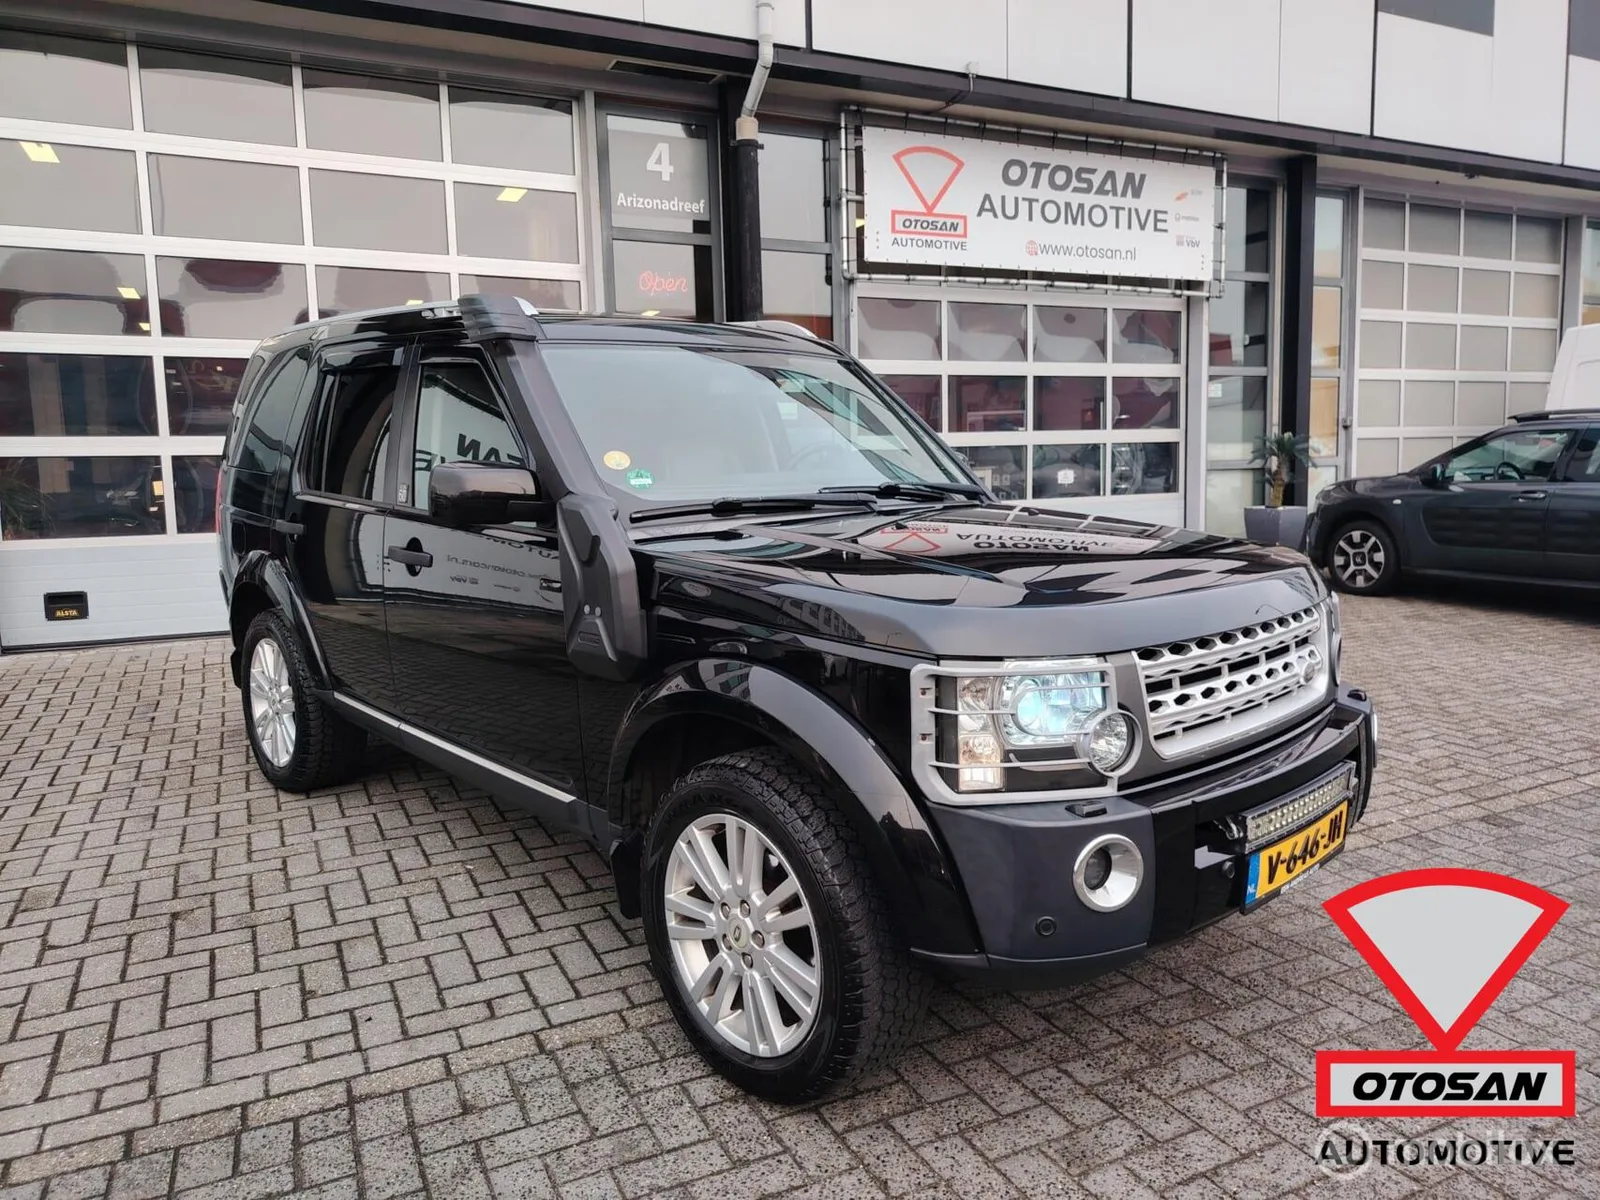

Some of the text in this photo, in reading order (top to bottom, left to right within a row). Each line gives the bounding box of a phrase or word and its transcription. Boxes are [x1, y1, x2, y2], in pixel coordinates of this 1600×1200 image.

[646, 142, 674, 181] 4
[1001, 158, 1146, 200] OTOSAN
[617, 192, 705, 214] Arizonadreef
[976, 193, 1169, 233] AUTOMOTIVE
[902, 218, 959, 232] OTOSAN
[891, 237, 968, 251] AUTOMOTIVE
[1038, 241, 1136, 261] www.otosan.nl
[638, 270, 688, 295] Open
